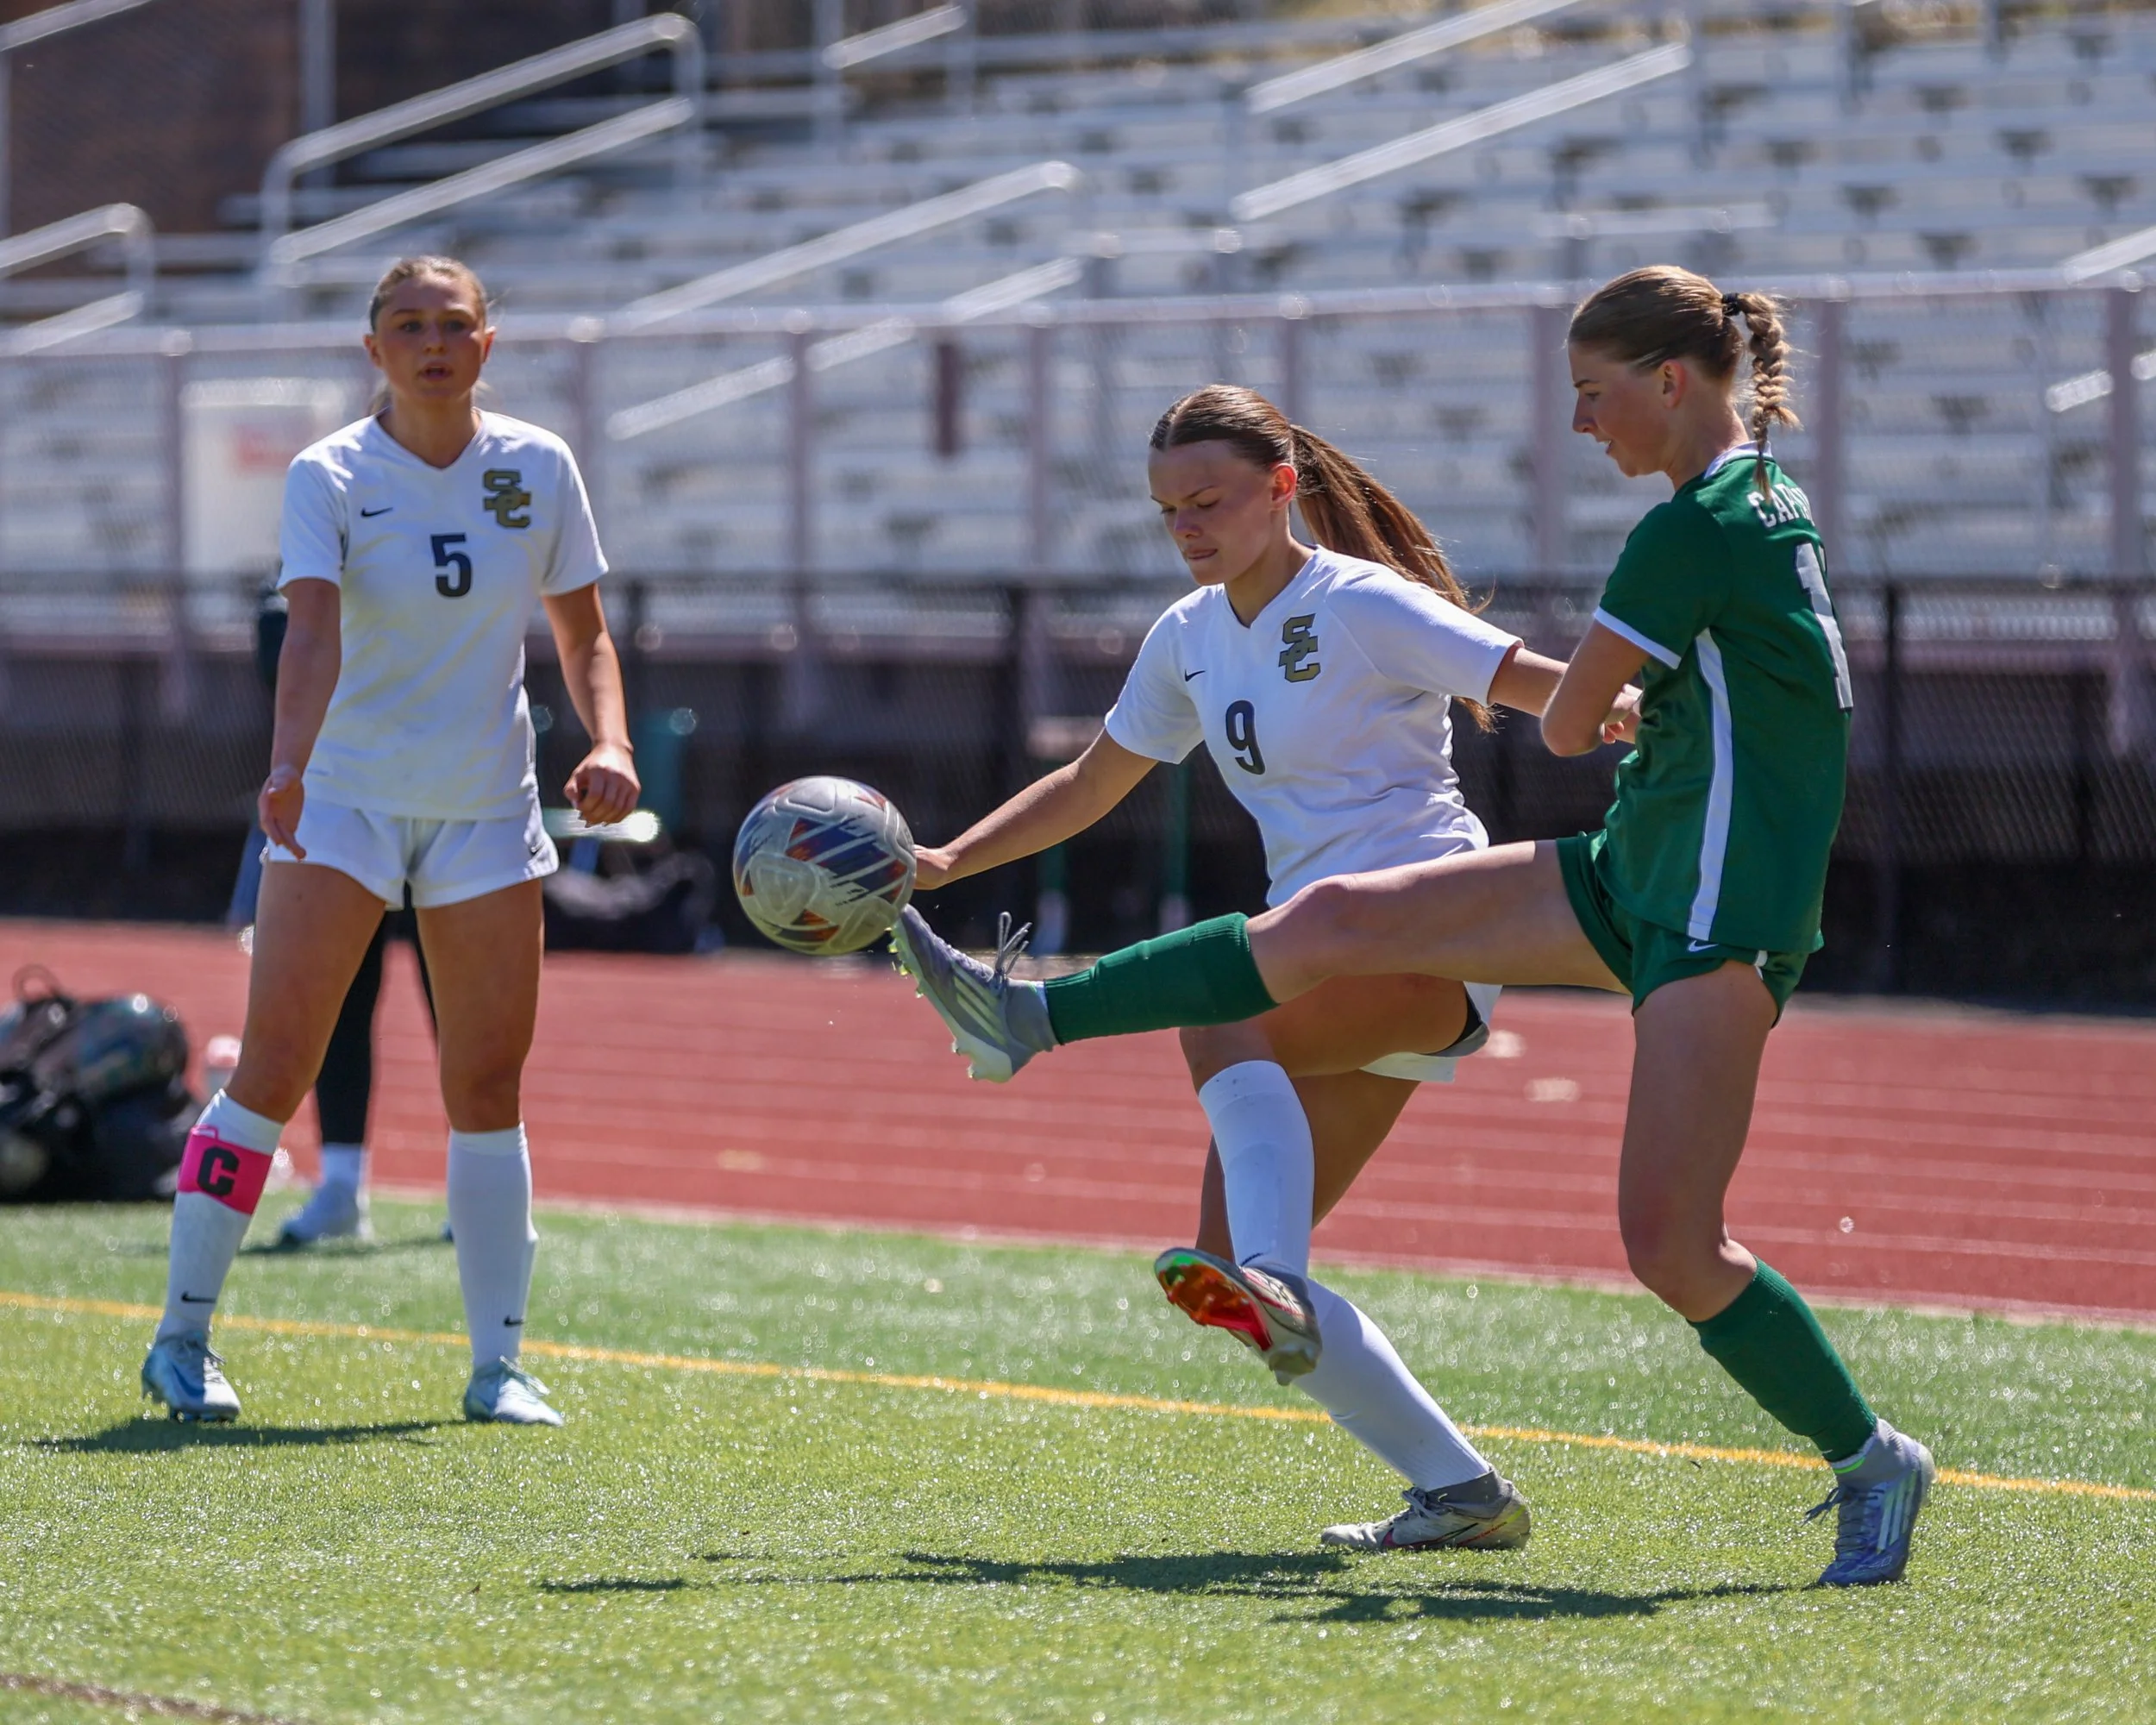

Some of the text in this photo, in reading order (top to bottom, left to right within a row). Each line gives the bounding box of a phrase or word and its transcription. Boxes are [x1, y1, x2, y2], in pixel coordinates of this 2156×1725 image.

[431, 533, 473, 599] 5
[1795, 542, 1854, 709] 1
[1225, 699, 1266, 775] 9
[197, 1146, 239, 1197] C
